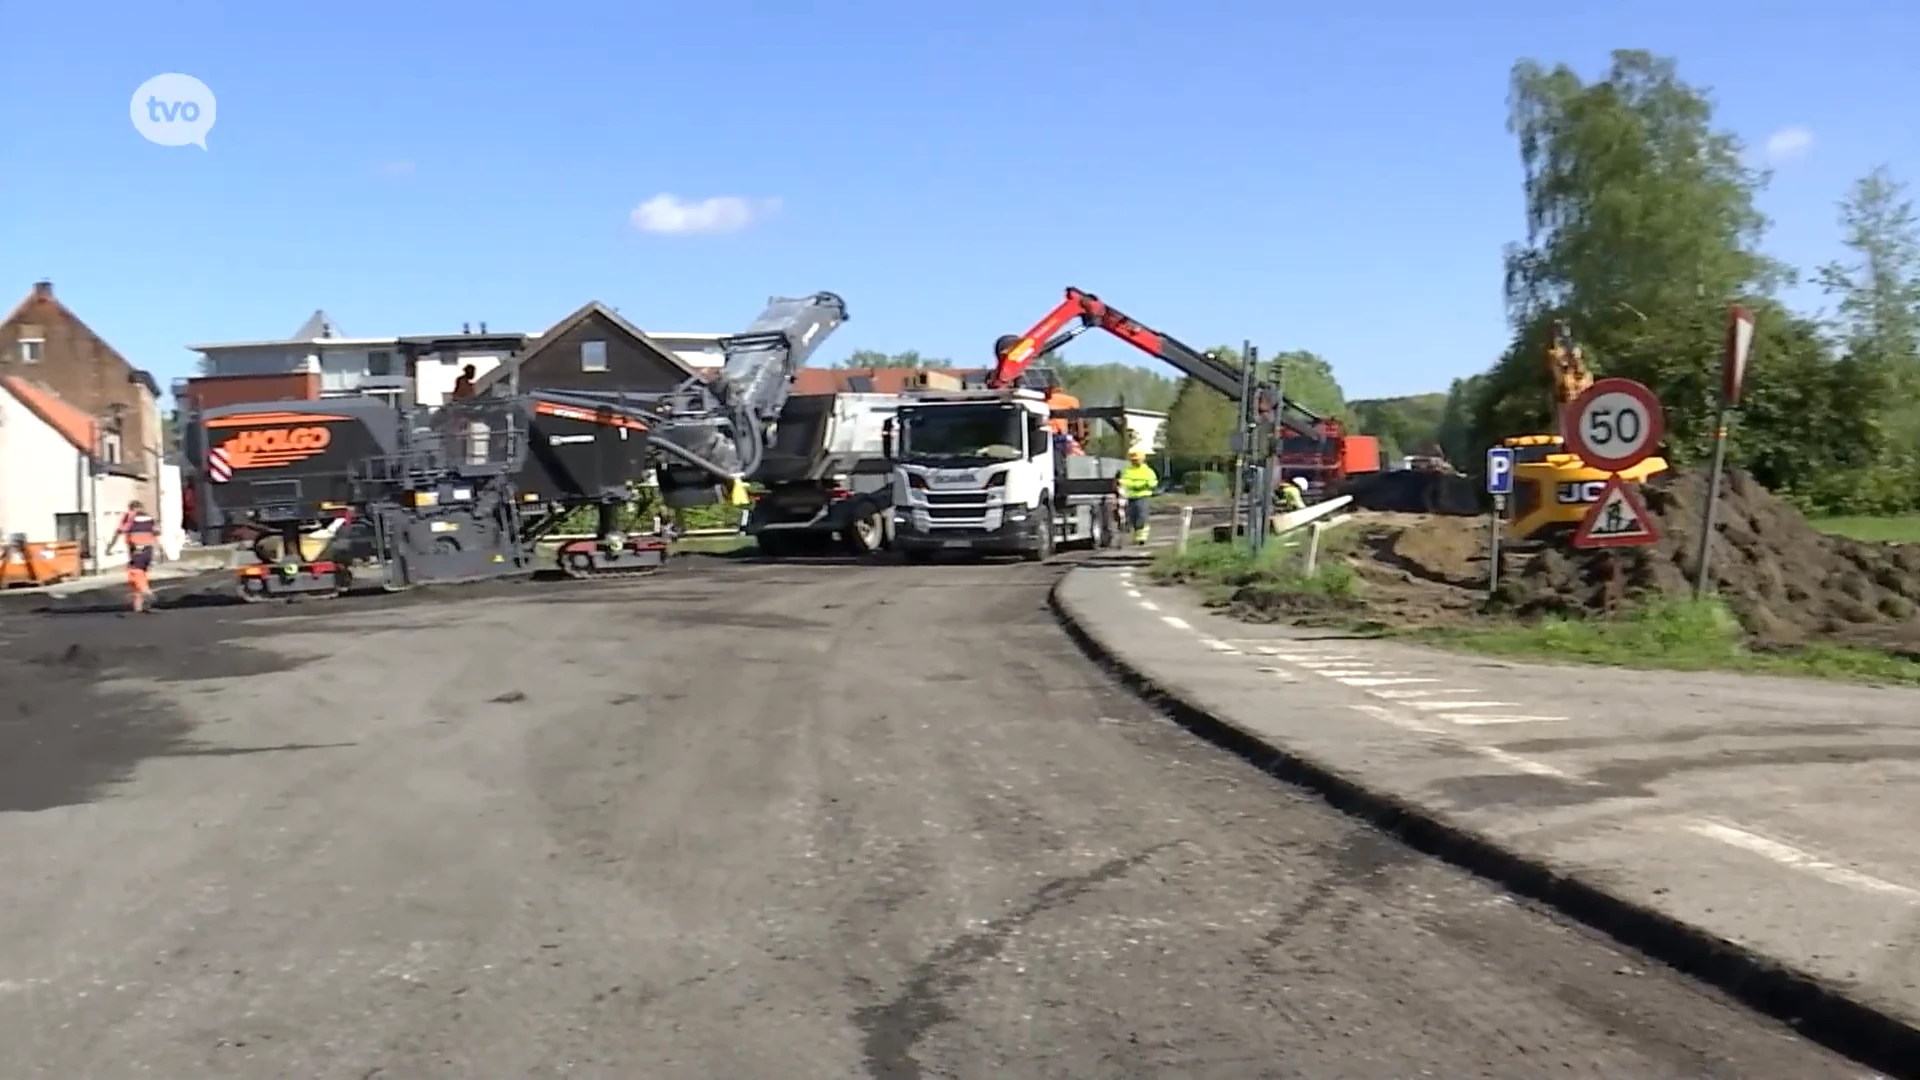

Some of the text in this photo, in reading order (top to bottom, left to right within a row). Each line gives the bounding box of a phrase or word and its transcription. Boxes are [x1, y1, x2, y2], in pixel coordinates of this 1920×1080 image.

[1590, 408, 1640, 444] 50
[1490, 456, 1509, 485] P
[1558, 481, 1608, 502] JC
